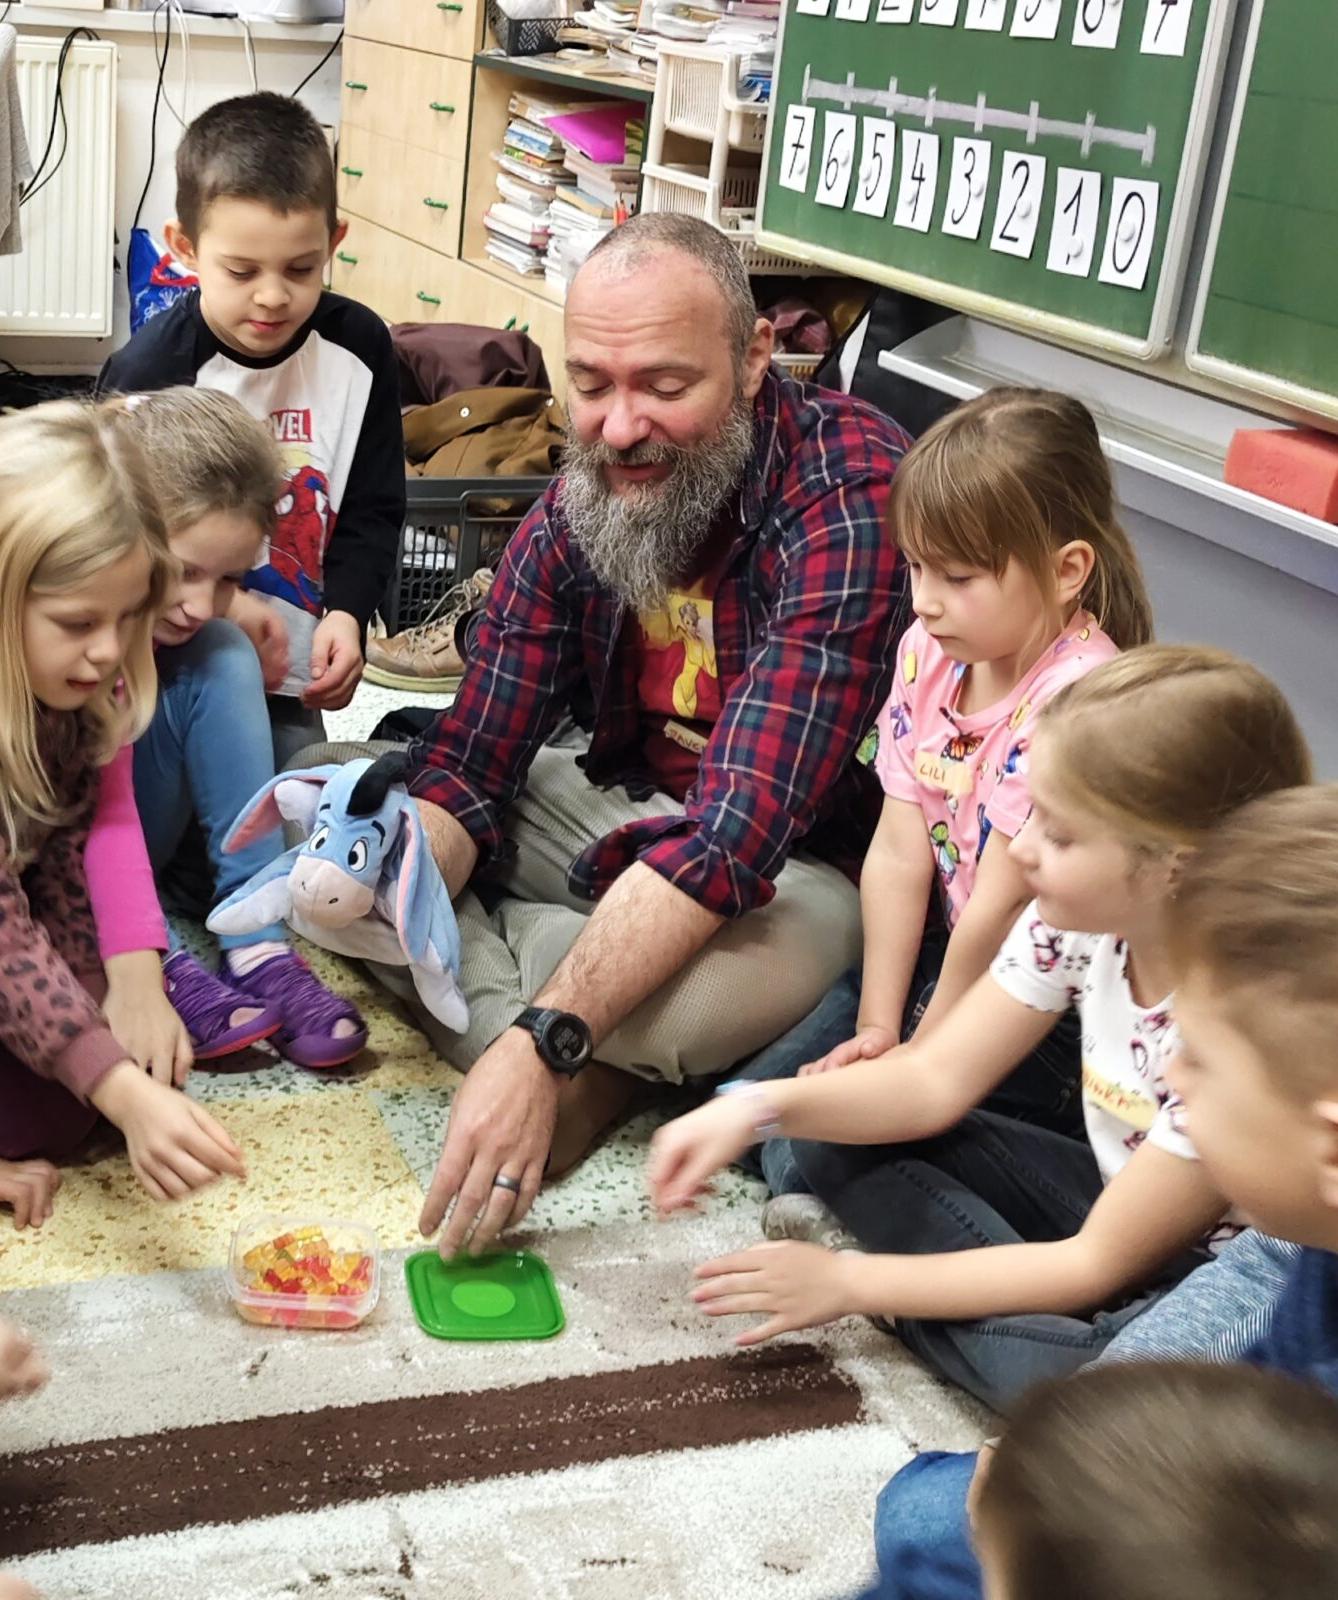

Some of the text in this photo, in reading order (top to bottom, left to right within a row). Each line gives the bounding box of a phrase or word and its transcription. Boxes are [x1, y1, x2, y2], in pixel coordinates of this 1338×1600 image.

[789, 115, 1146, 273] 7 6 5 4 3 2 1 0
[273, 412, 309, 440] VEL
[920, 763, 946, 782] LILI
